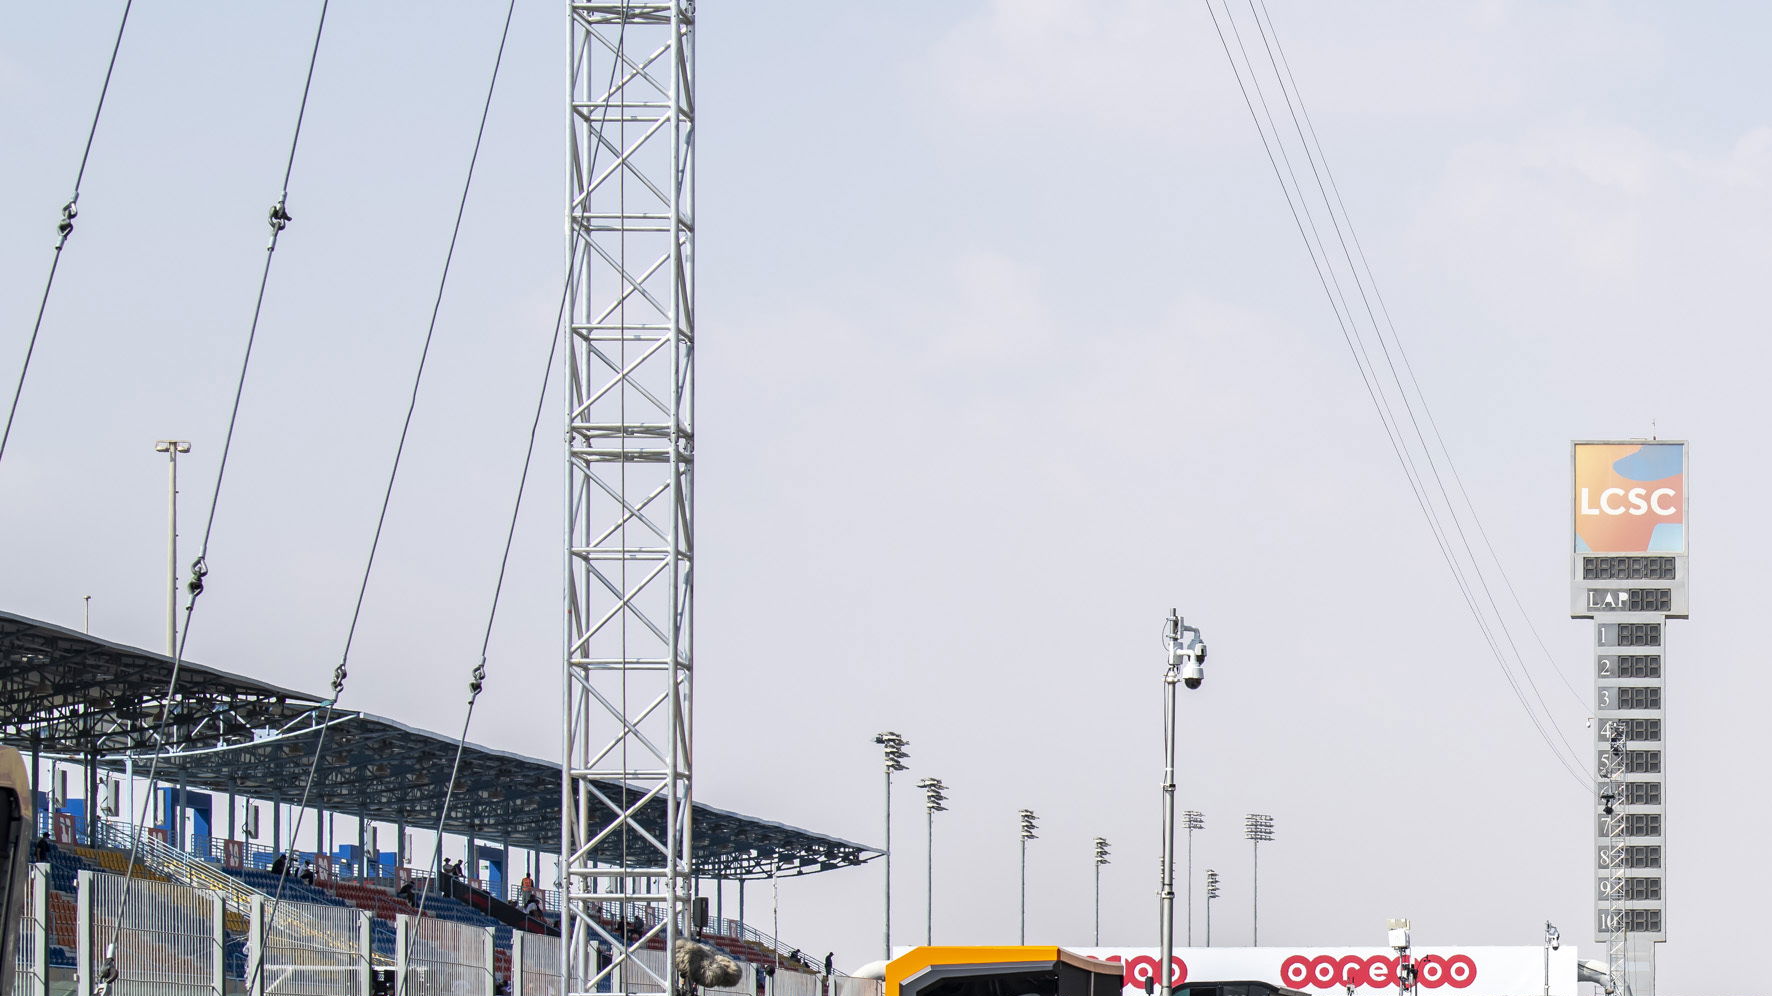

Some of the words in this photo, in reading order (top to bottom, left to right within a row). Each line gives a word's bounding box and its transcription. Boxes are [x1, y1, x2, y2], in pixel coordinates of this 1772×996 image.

[1581, 487, 1677, 516] LCSC
[1588, 592, 1629, 608] LAP
[1600, 628, 1606, 643] 1
[1600, 660, 1610, 675] 2
[1600, 691, 1610, 706] 3
[1600, 721, 1611, 738] 4
[1601, 818, 1609, 834] 7
[1600, 849, 1609, 865] 8
[1600, 881, 1610, 896] 9
[1600, 913, 1617, 929] 10
